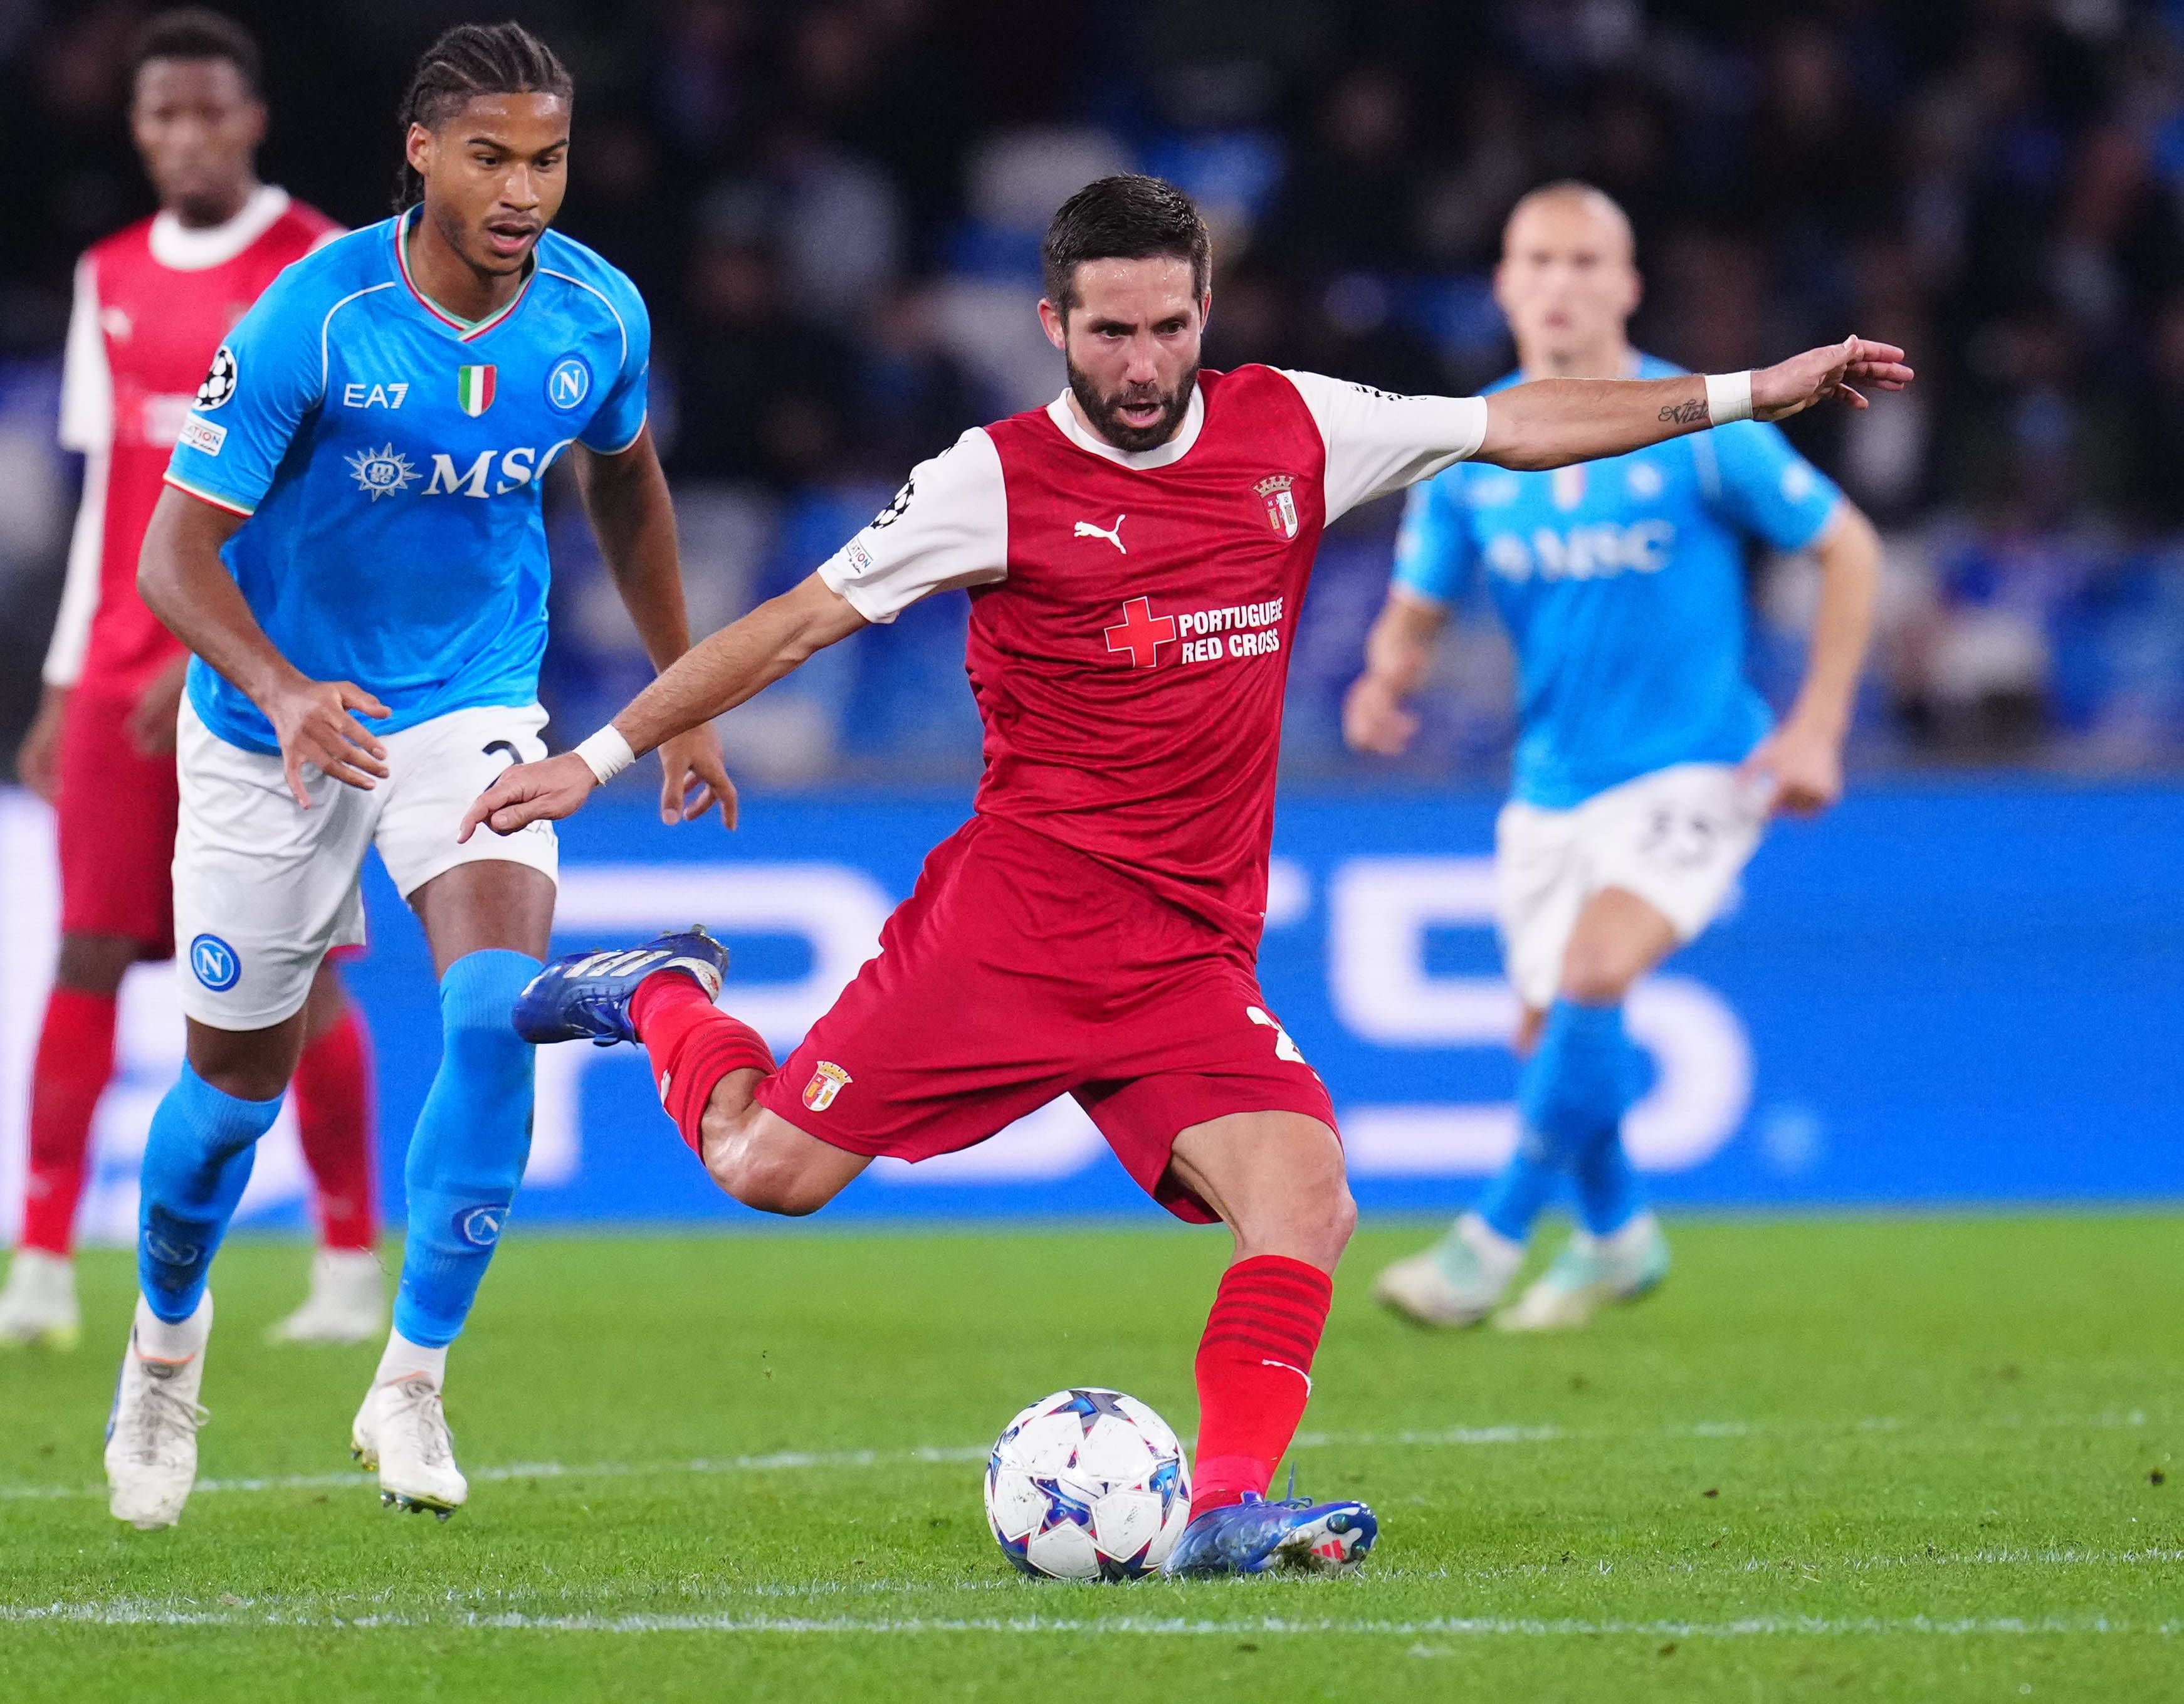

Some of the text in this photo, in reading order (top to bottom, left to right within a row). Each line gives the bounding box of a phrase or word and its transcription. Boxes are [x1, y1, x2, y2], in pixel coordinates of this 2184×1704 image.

[343, 382, 409, 409] EA7
[557, 369, 581, 401] N
[1178, 597, 1283, 638] PORTUGUESE
[1182, 628, 1280, 665] RED CROSS
[201, 947, 224, 979] N
